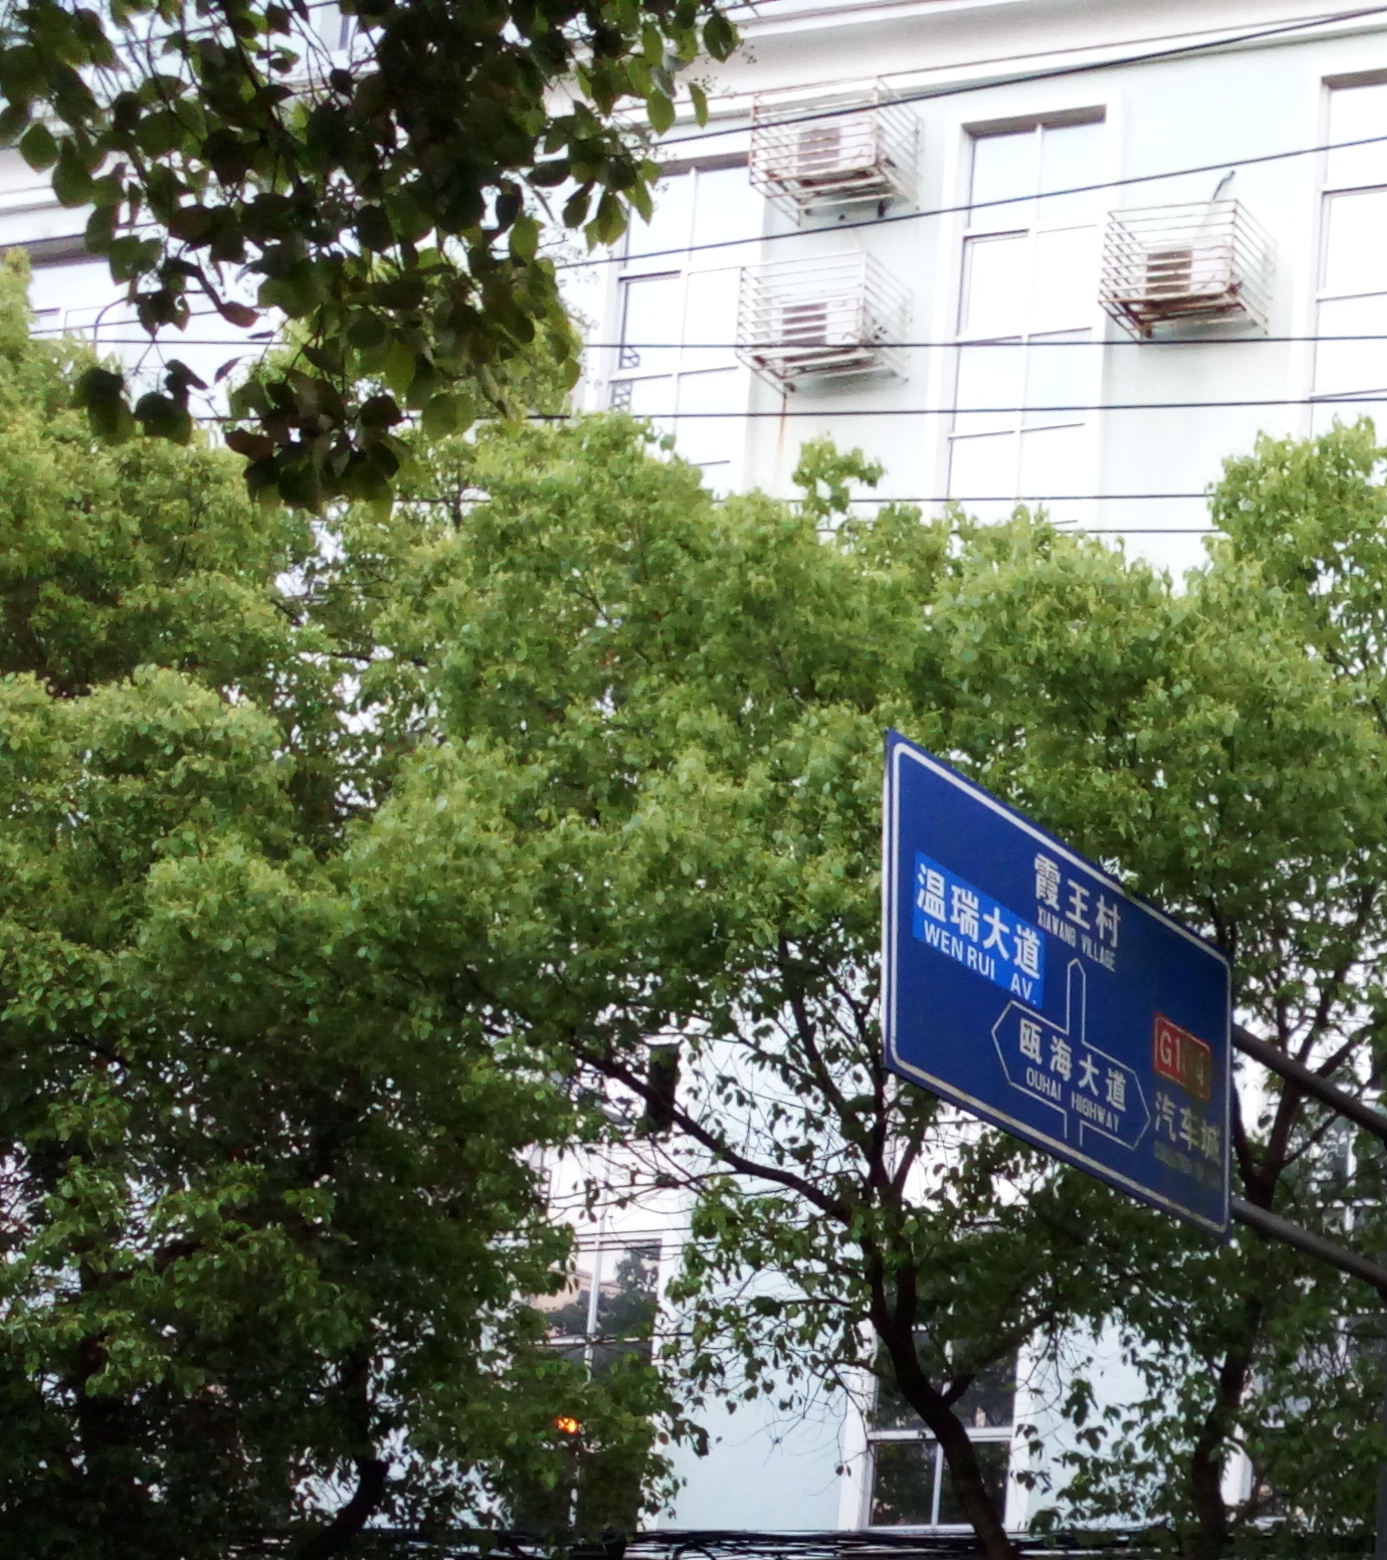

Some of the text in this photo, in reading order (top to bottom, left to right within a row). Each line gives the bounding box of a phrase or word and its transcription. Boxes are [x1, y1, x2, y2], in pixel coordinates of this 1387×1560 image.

[917, 863, 1041, 980] 温瑞大道
[1034, 853, 1121, 948] 霞王村
[924, 919, 1037, 1005] WEN RUI AV.
[1020, 1017, 1126, 1112] 瓯海大道
[1026, 1067, 1119, 1133] OUHAI HIGHWAY
[1155, 1091, 1221, 1167] 汽车城
